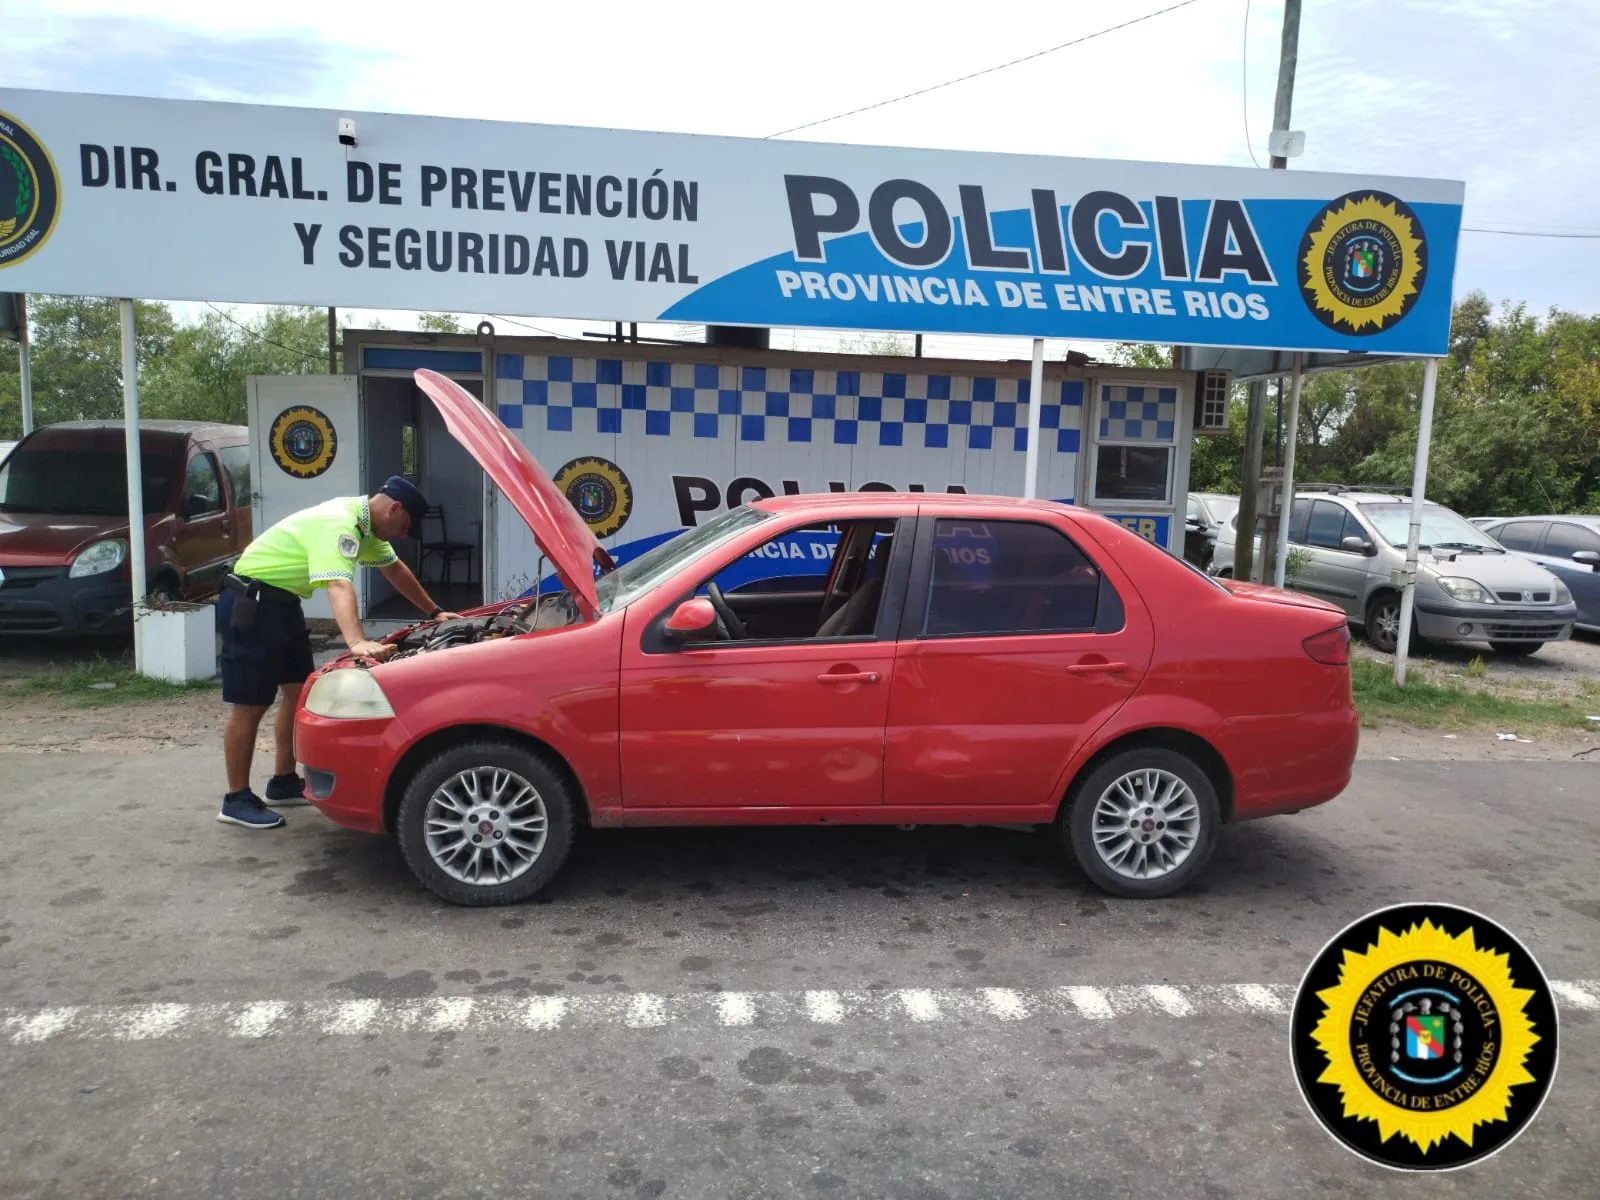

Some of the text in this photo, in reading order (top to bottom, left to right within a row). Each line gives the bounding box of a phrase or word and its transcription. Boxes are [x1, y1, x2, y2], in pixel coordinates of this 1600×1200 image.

[80, 143, 699, 222] DIR. GRAL. DE PREVENCIÓN
[293, 223, 699, 284] Y SEGURIDAD VIAL
[783, 174, 1279, 287] POLICIA
[1326, 222, 1363, 256] JEFATURA
[1365, 221, 1379, 232] DE
[776, 269, 1270, 321] PROVINCIA DE ENTRE RIOS
[1326, 266, 1350, 304] PROVINCIA
[1351, 298, 1363, 306] DE
[1364, 287, 1389, 306] ENTRE
